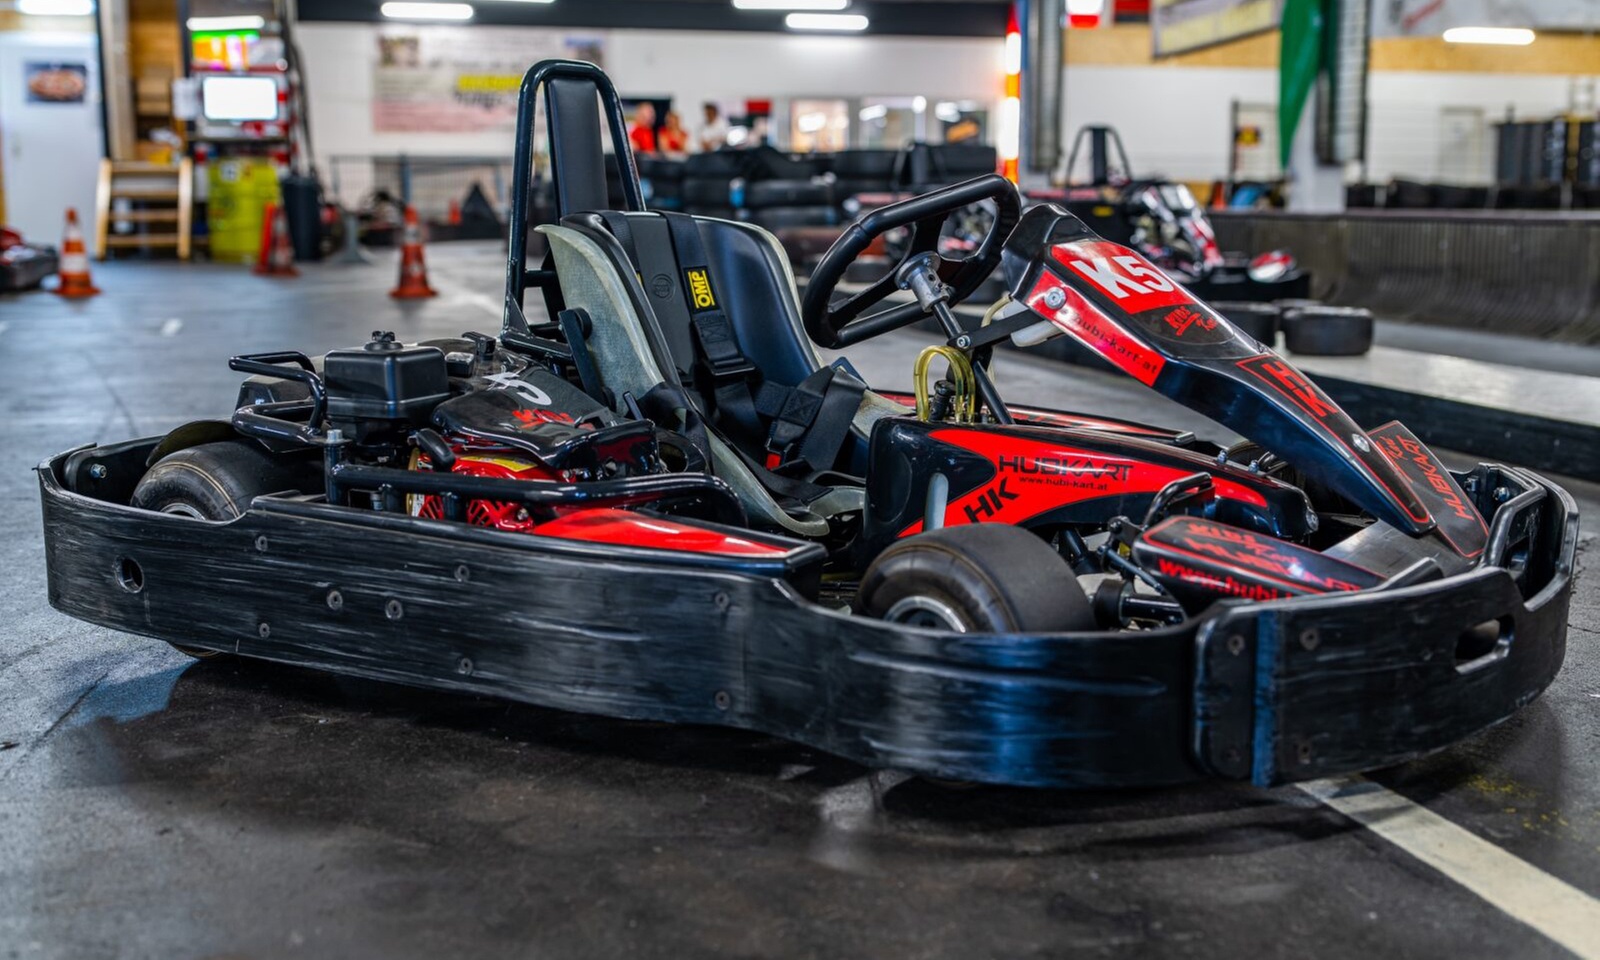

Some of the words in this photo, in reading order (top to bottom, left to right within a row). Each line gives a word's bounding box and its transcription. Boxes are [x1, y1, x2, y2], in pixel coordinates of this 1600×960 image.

[690, 271, 712, 308] OMP
[1069, 255, 1175, 299] K5
[1261, 361, 1339, 417] HK
[964, 476, 1021, 523] HK
